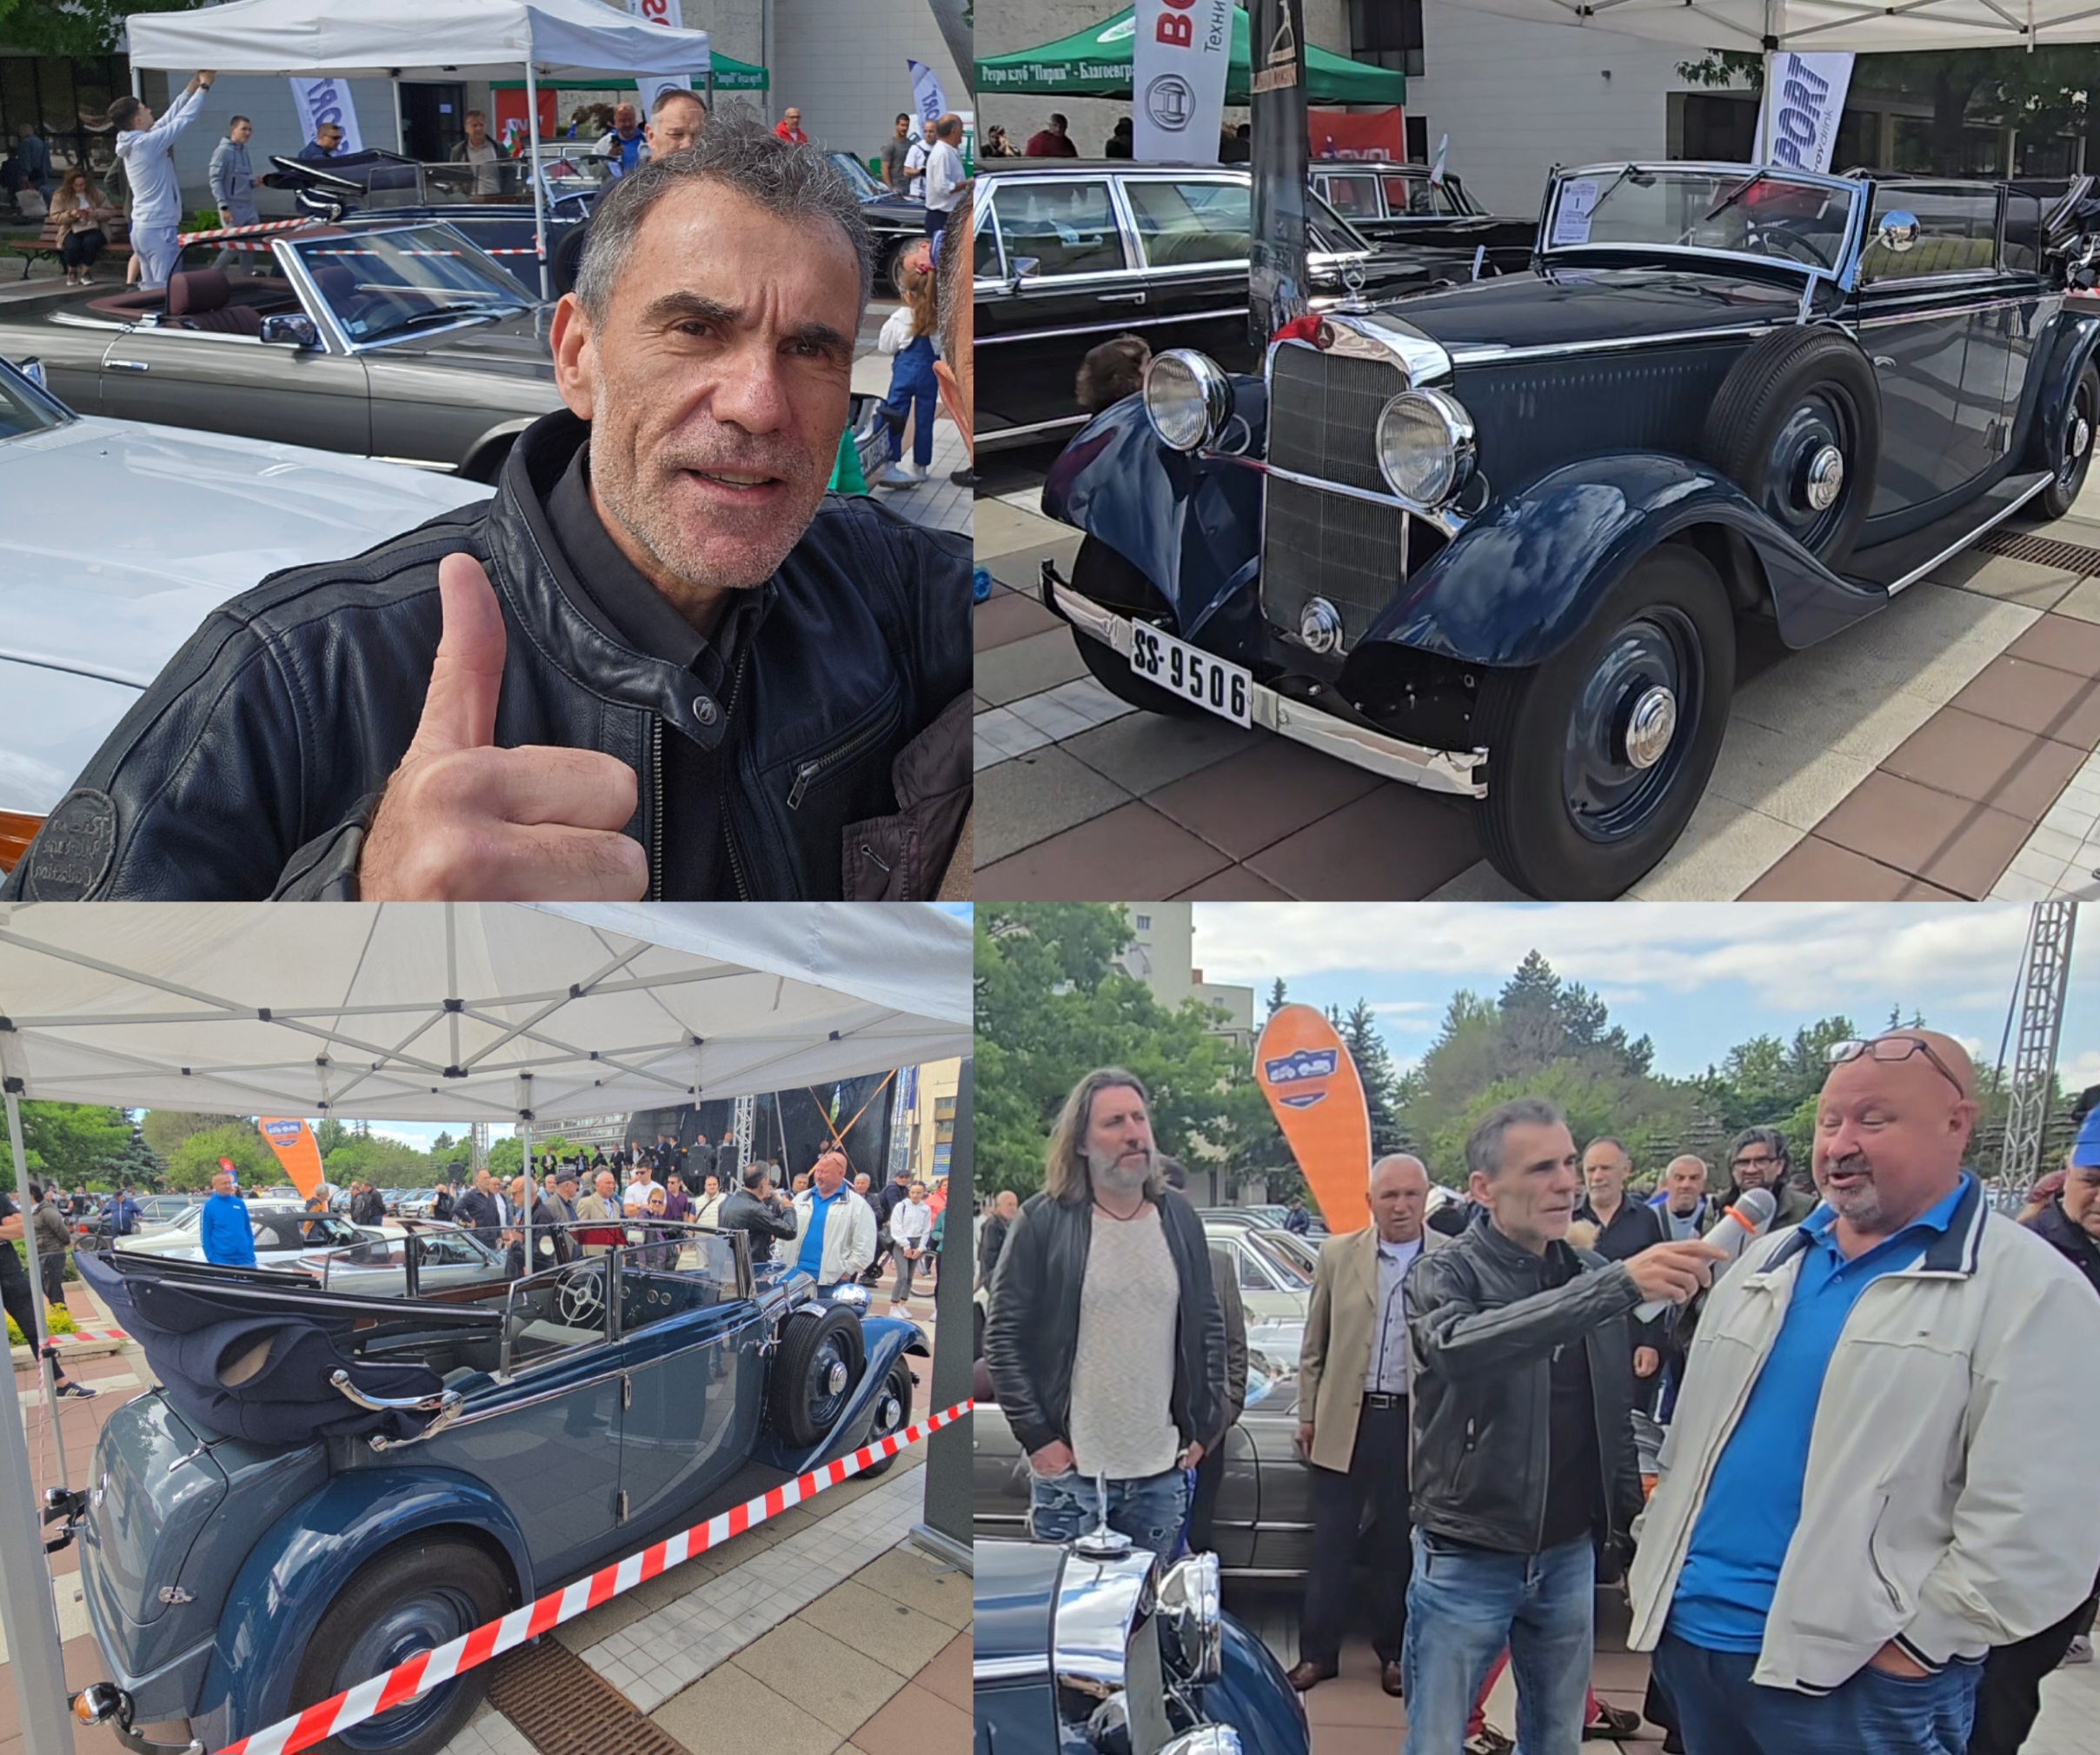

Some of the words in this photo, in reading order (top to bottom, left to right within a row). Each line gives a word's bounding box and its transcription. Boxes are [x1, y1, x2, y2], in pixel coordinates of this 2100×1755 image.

[981, 65, 1007, 85] Ретро
[1079, 62, 1134, 83] Благоевгр
[1771, 52, 1829, 171] PORT
